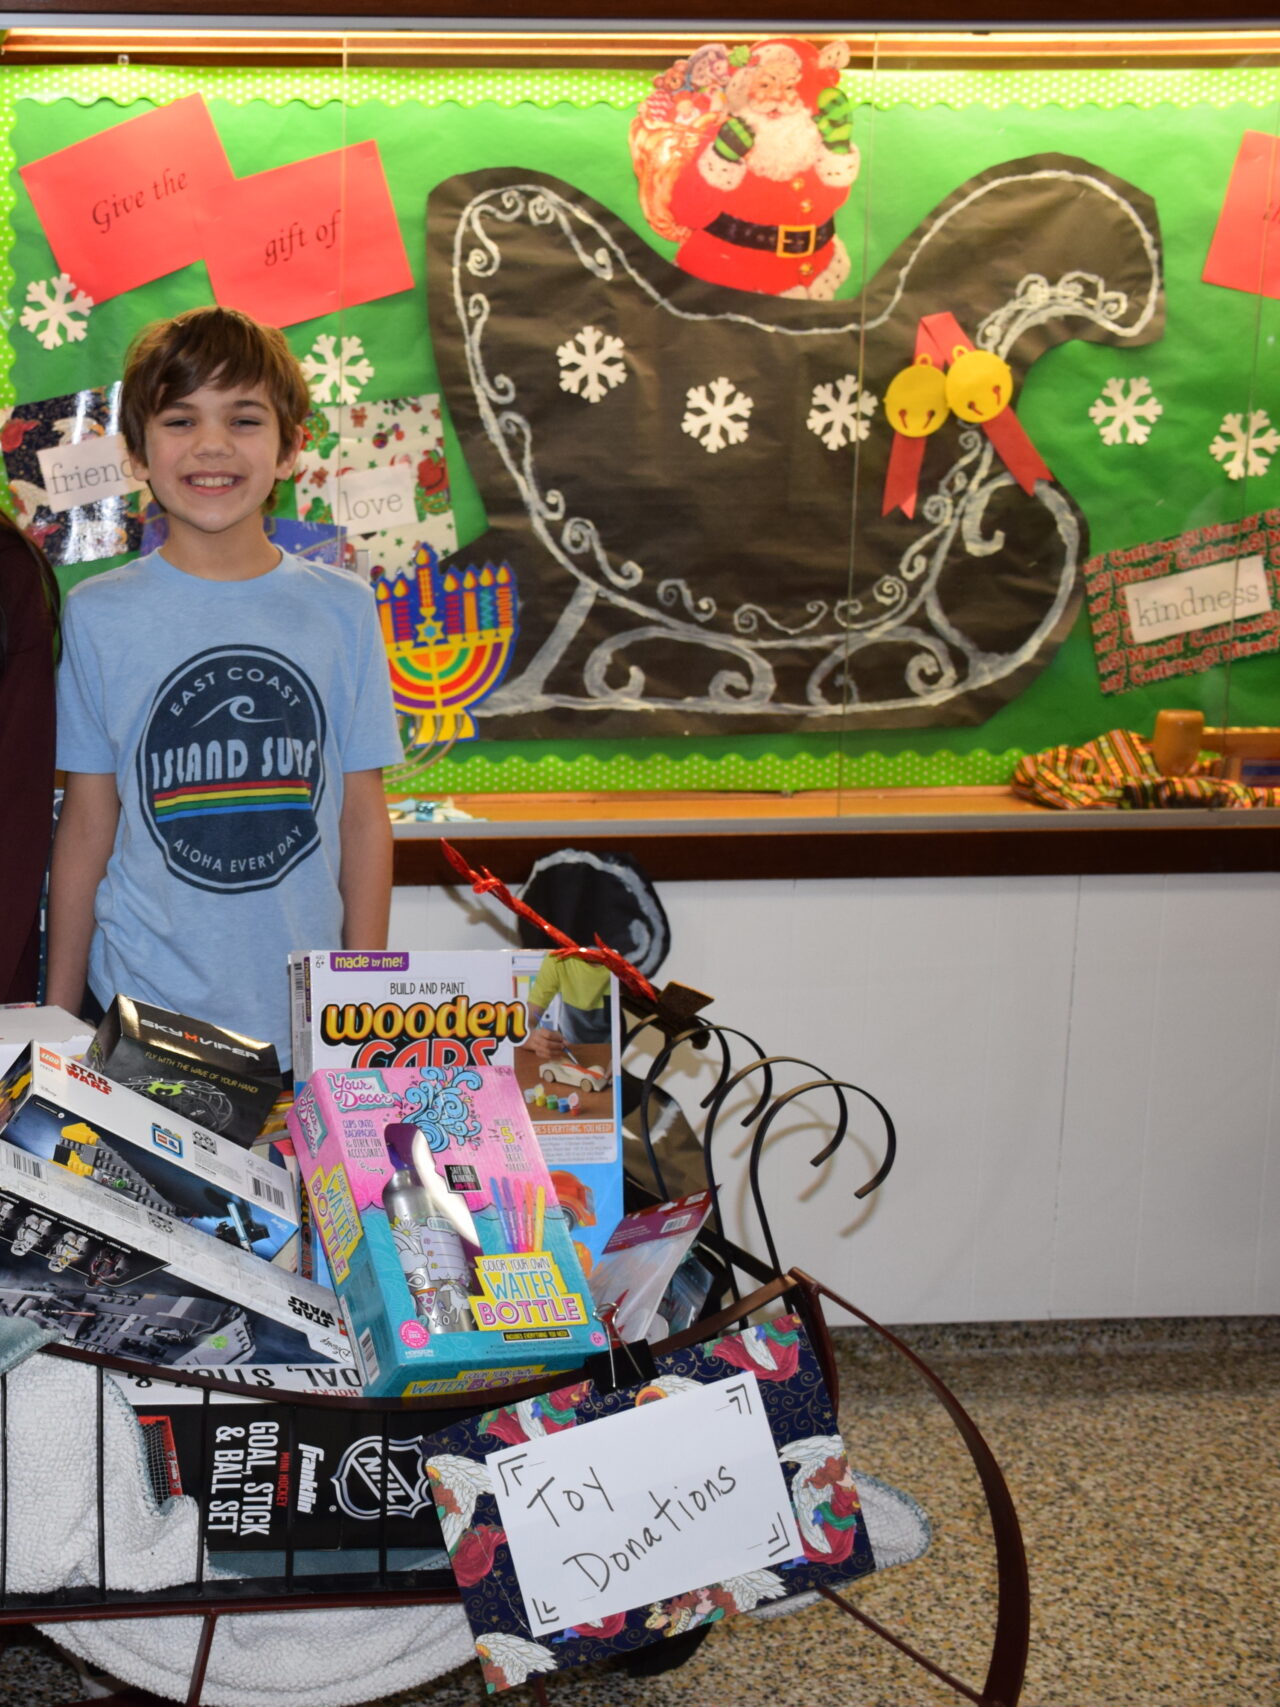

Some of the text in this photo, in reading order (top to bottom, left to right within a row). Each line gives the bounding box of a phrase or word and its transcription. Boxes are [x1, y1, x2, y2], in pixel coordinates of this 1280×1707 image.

[92, 167, 187, 234] Give the
[264, 208, 341, 266] gift of
[342, 489, 404, 523] love
[1136, 583, 1260, 627] kindness
[170, 667, 300, 717] EAST COAST
[150, 737, 316, 790] ISLAND SURF
[173, 825, 302, 873] ALOHA EVERY DAY
[335, 955, 369, 968] made
[372, 959, 381, 967] by
[382, 957, 404, 967] me!
[390, 982, 467, 995] BUILD AND PAINT
[323, 996, 527, 1041] wooden
[140, 1019, 260, 1061] SKY VIPER
[65, 1063, 109, 1086] STAR
[66, 1067, 112, 1096] WARS
[145, 1052, 259, 1094] FLY WITH THE WAVE OF YOUR HAND!
[327, 1072, 373, 1098] Your
[333, 1090, 394, 1109] Decor
[500, 1126, 515, 1143] 5
[311, 1175, 347, 1277] BOTTLE
[326, 1174, 353, 1251] WATER
[482, 1257, 551, 1272] COLOR YOUR OWN
[483, 1271, 559, 1300] WATER
[288, 1295, 336, 1326] WARS
[288, 1301, 331, 1329] STAR
[477, 1297, 581, 1326] BOTTLE
[411, 1380, 469, 1395] WATER
[207, 1425, 246, 1533] & BALL SET
[239, 1421, 280, 1536] GOAL, STICK
[276, 1451, 291, 1508] MINI HOCKEY
[562, 1465, 737, 1593] Donations
